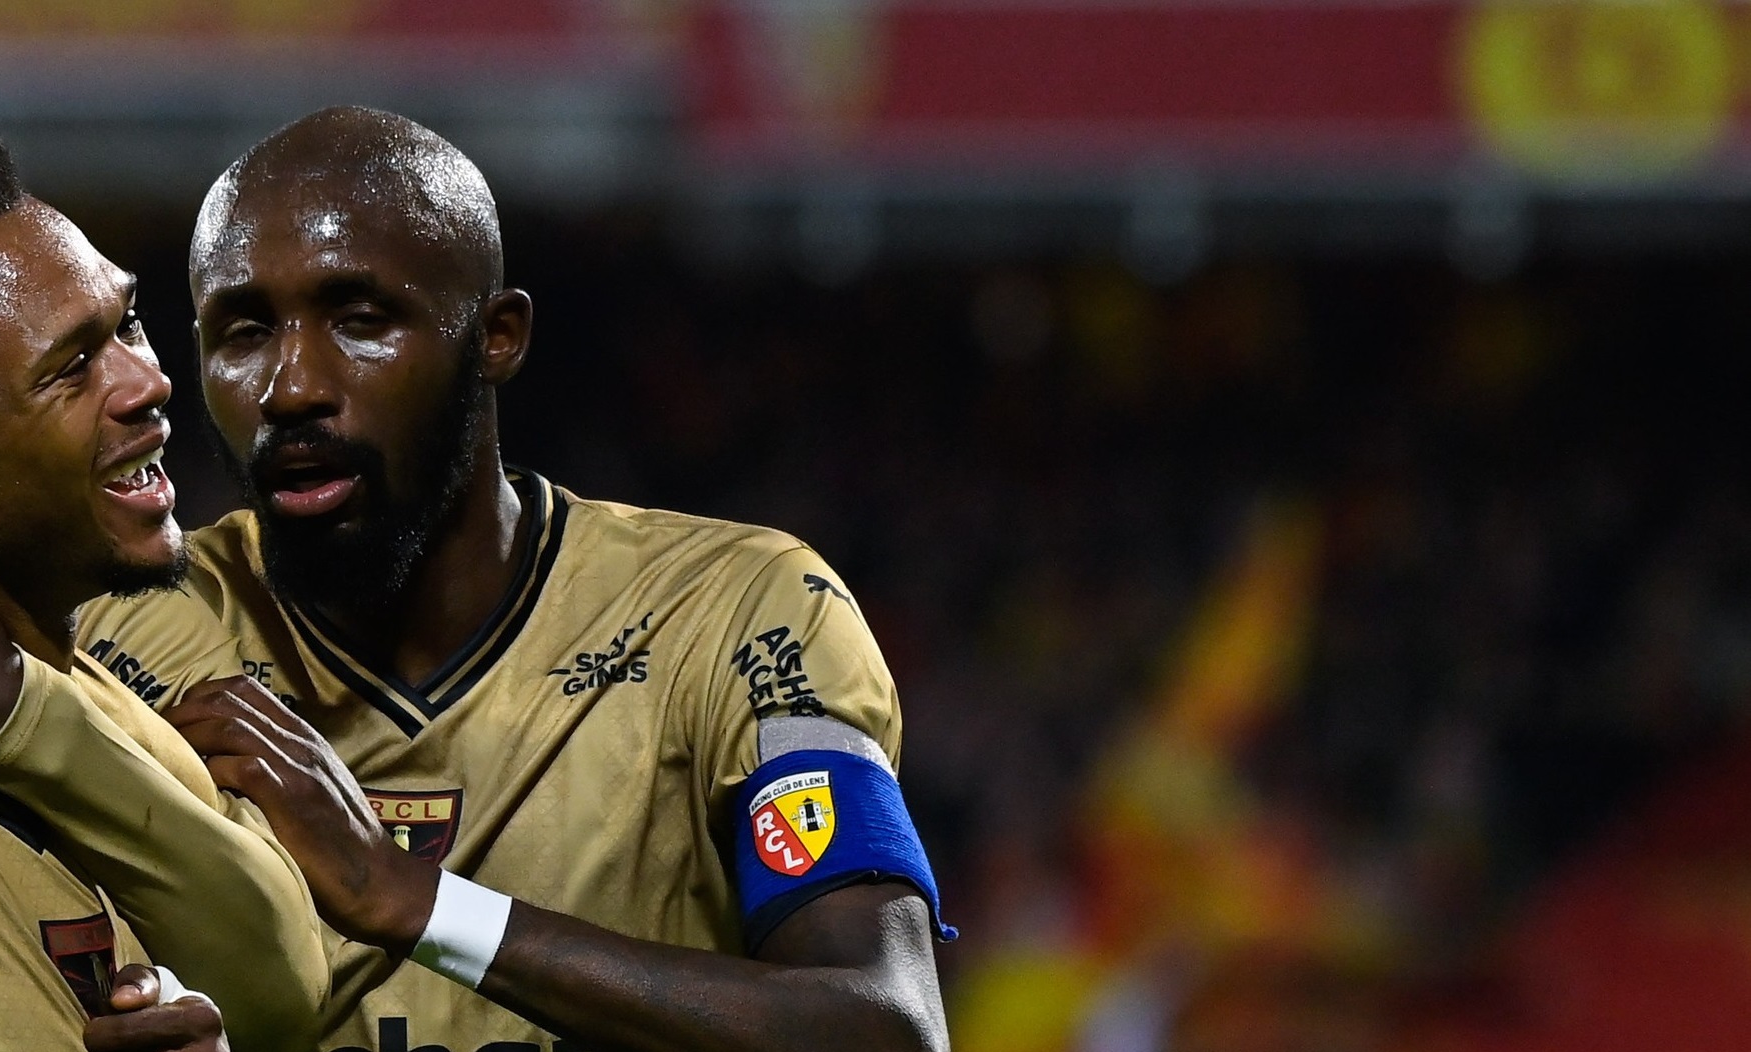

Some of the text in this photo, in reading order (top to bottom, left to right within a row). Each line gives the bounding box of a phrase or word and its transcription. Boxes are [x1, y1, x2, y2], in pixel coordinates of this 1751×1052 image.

[772, 783, 792, 796] CLUB
[793, 779, 804, 789] DE
[805, 776, 825, 786] LENS
[369, 800, 438, 819] RCL
[756, 811, 805, 870] RCL
